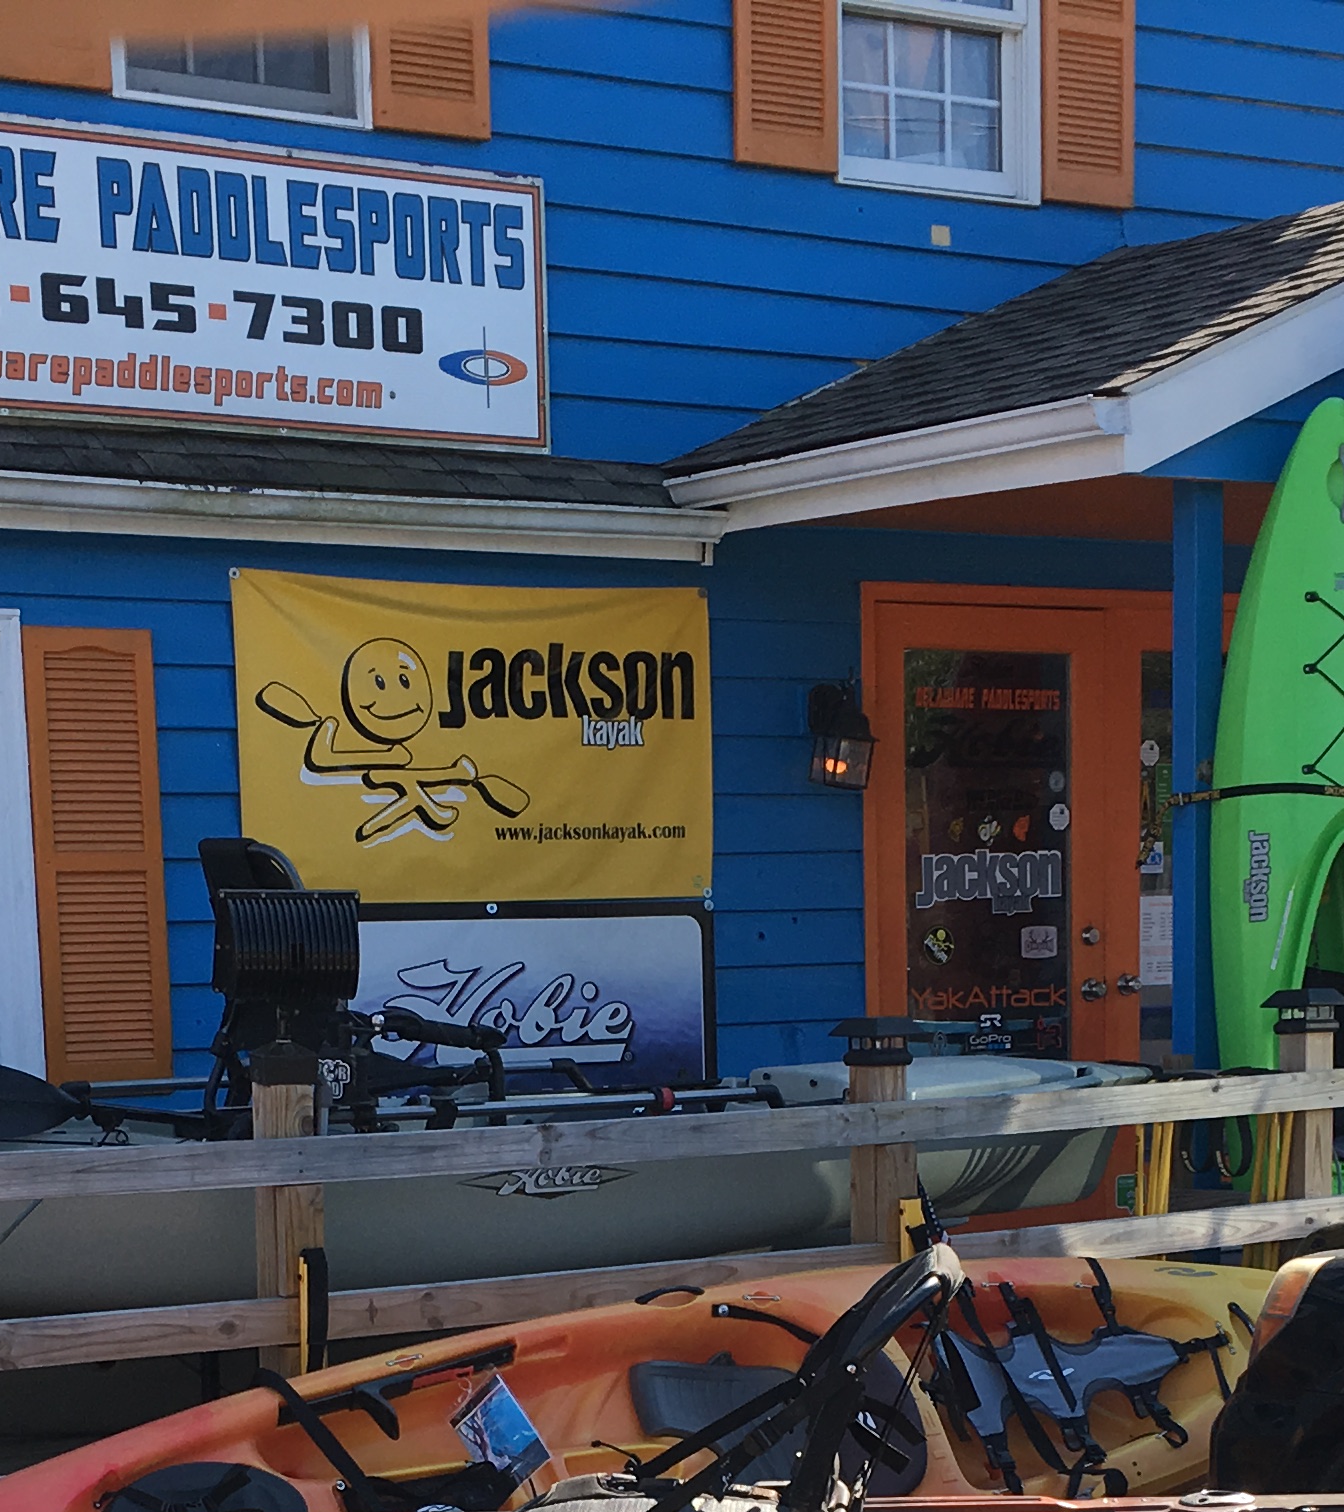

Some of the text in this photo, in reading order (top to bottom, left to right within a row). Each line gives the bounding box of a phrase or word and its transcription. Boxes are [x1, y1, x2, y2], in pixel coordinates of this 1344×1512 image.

[96, 156, 526, 291] PADDLESPORTS
[581, 714, 645, 749] kayak
[494, 822, 686, 844] www.jacksonkayak.com
[368, 959, 637, 1067] Hobie
[911, 984, 1067, 1011] YakAttack
[969, 1034, 1012, 1045] GoPro
[496, 1166, 603, 1197] Hobie
